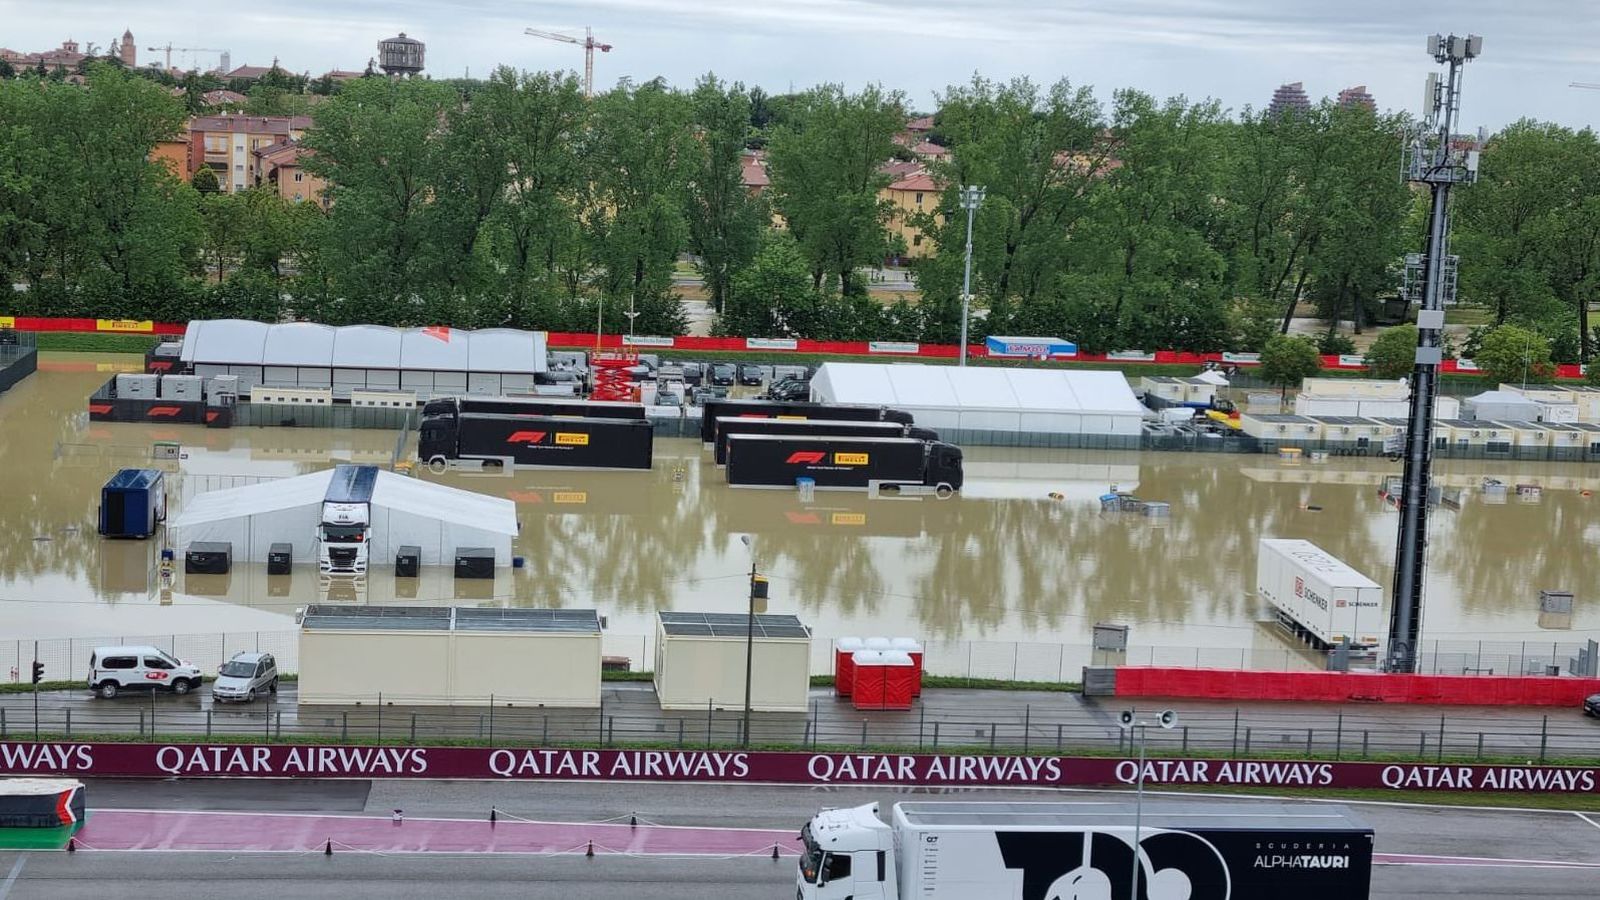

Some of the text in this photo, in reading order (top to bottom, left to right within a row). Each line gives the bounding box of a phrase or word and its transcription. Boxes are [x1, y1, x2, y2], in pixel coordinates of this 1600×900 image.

[507, 431, 586, 443] F1 PIRELLI
[786, 451, 866, 464] F1 PIRELLI
[1304, 586, 1328, 611] SCHENKER
[0, 745, 93, 770] WAYS
[156, 746, 427, 774] QATAR AIRWAYS
[489, 750, 749, 778] QATAR AIRWAYS
[807, 755, 1061, 781] QATAR AIRWAYS
[1115, 761, 1333, 785] QATAR AIRWAYS
[1381, 765, 1595, 791] QATAR AIRWAYS
[1254, 855, 1350, 868] ALPHATAURI
